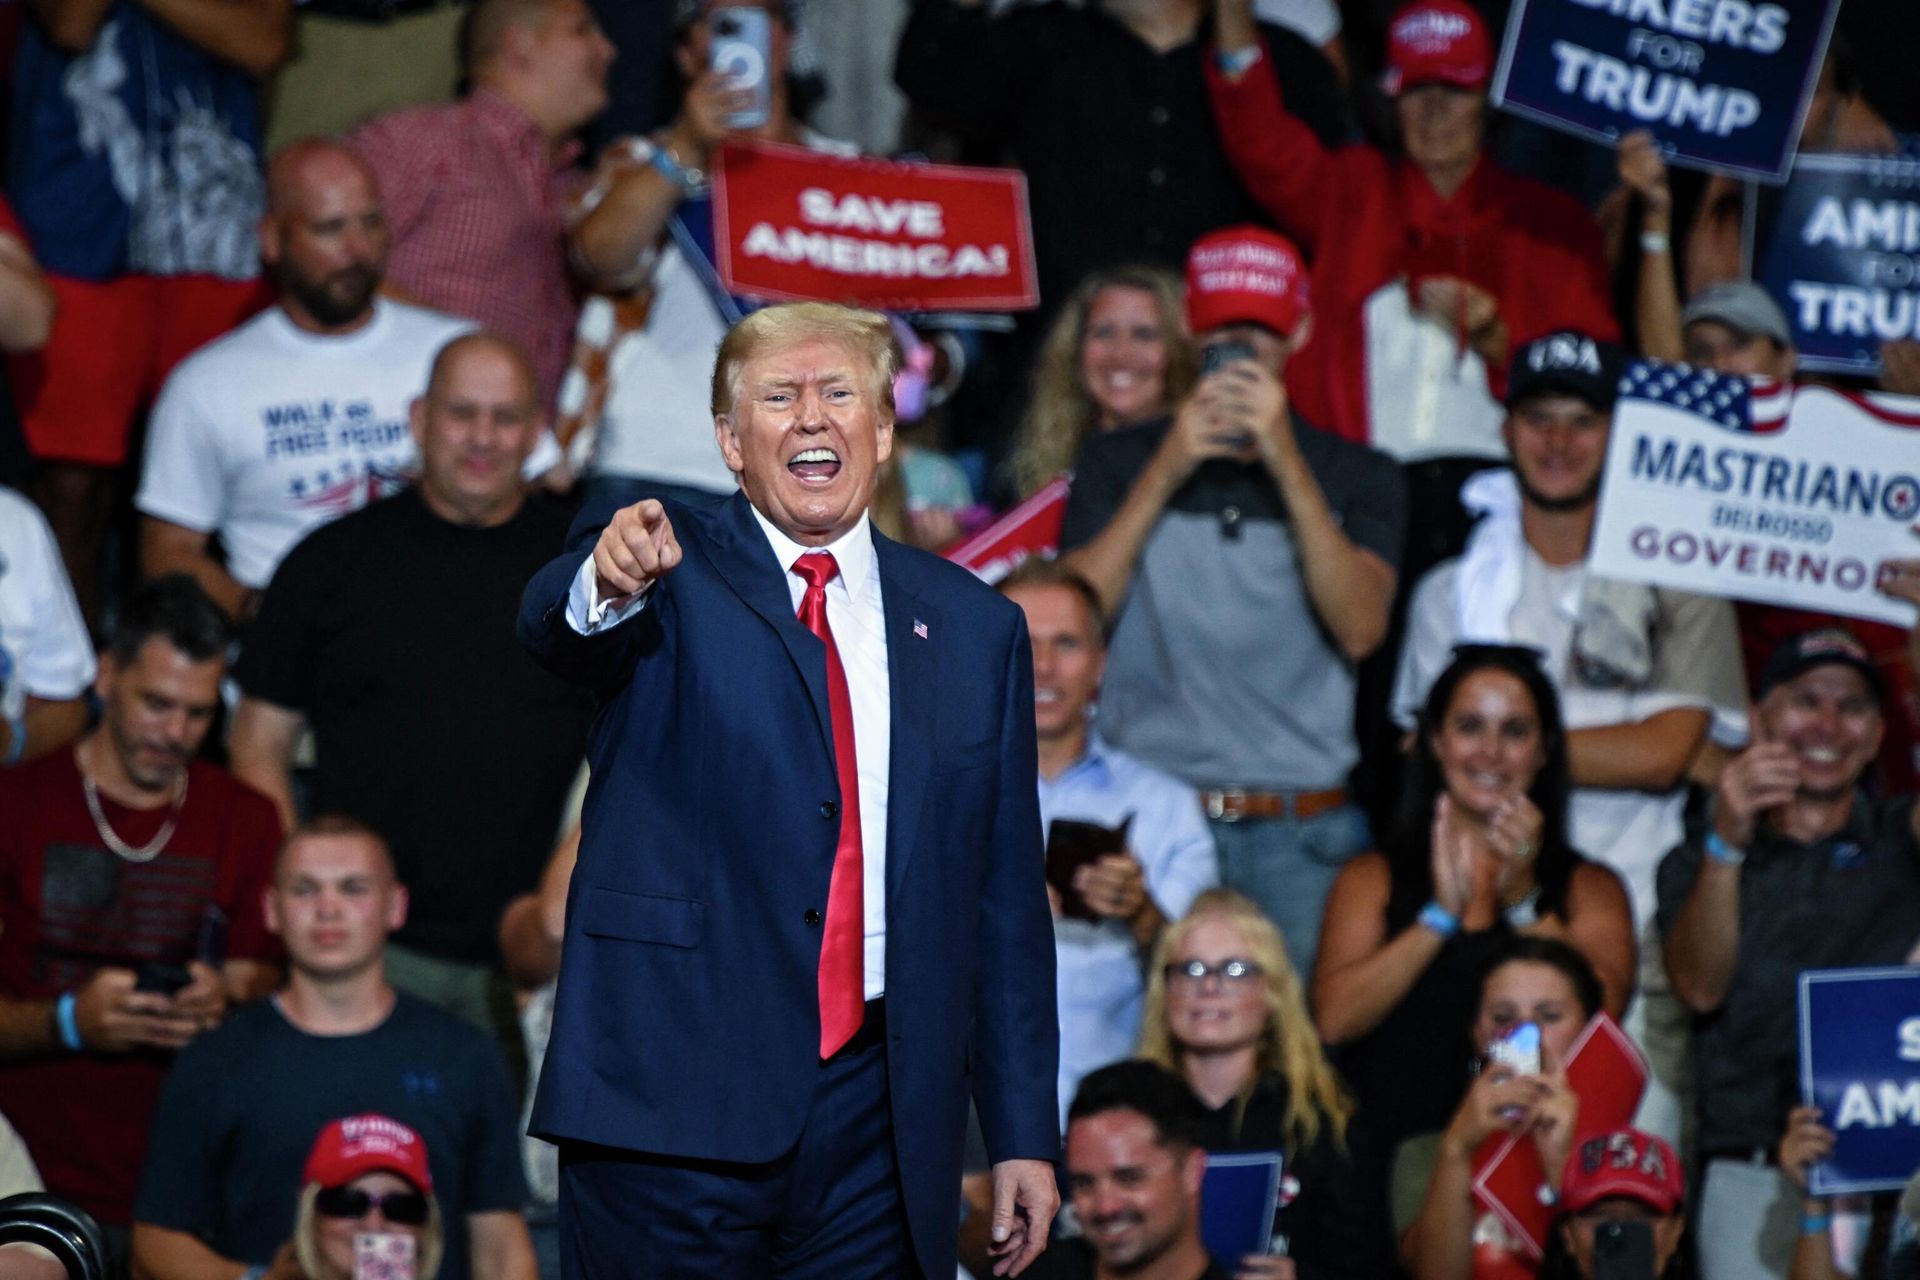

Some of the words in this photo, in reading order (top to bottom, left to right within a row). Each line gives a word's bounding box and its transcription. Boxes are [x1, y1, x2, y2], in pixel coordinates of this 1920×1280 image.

[1574, 0, 1791, 53] KERS
[1628, 28, 1705, 73] FOR
[1552, 40, 1761, 137] TRUMP
[798, 187, 945, 238] SAVE
[743, 221, 1011, 278] AMERICA!
[1861, 252, 1920, 289] FO
[1789, 280, 1920, 342] TRU
[1629, 434, 1920, 523] MASTRIANO
[1834, 1077, 1920, 1130] AM
[1581, 1131, 1667, 1181] USA
